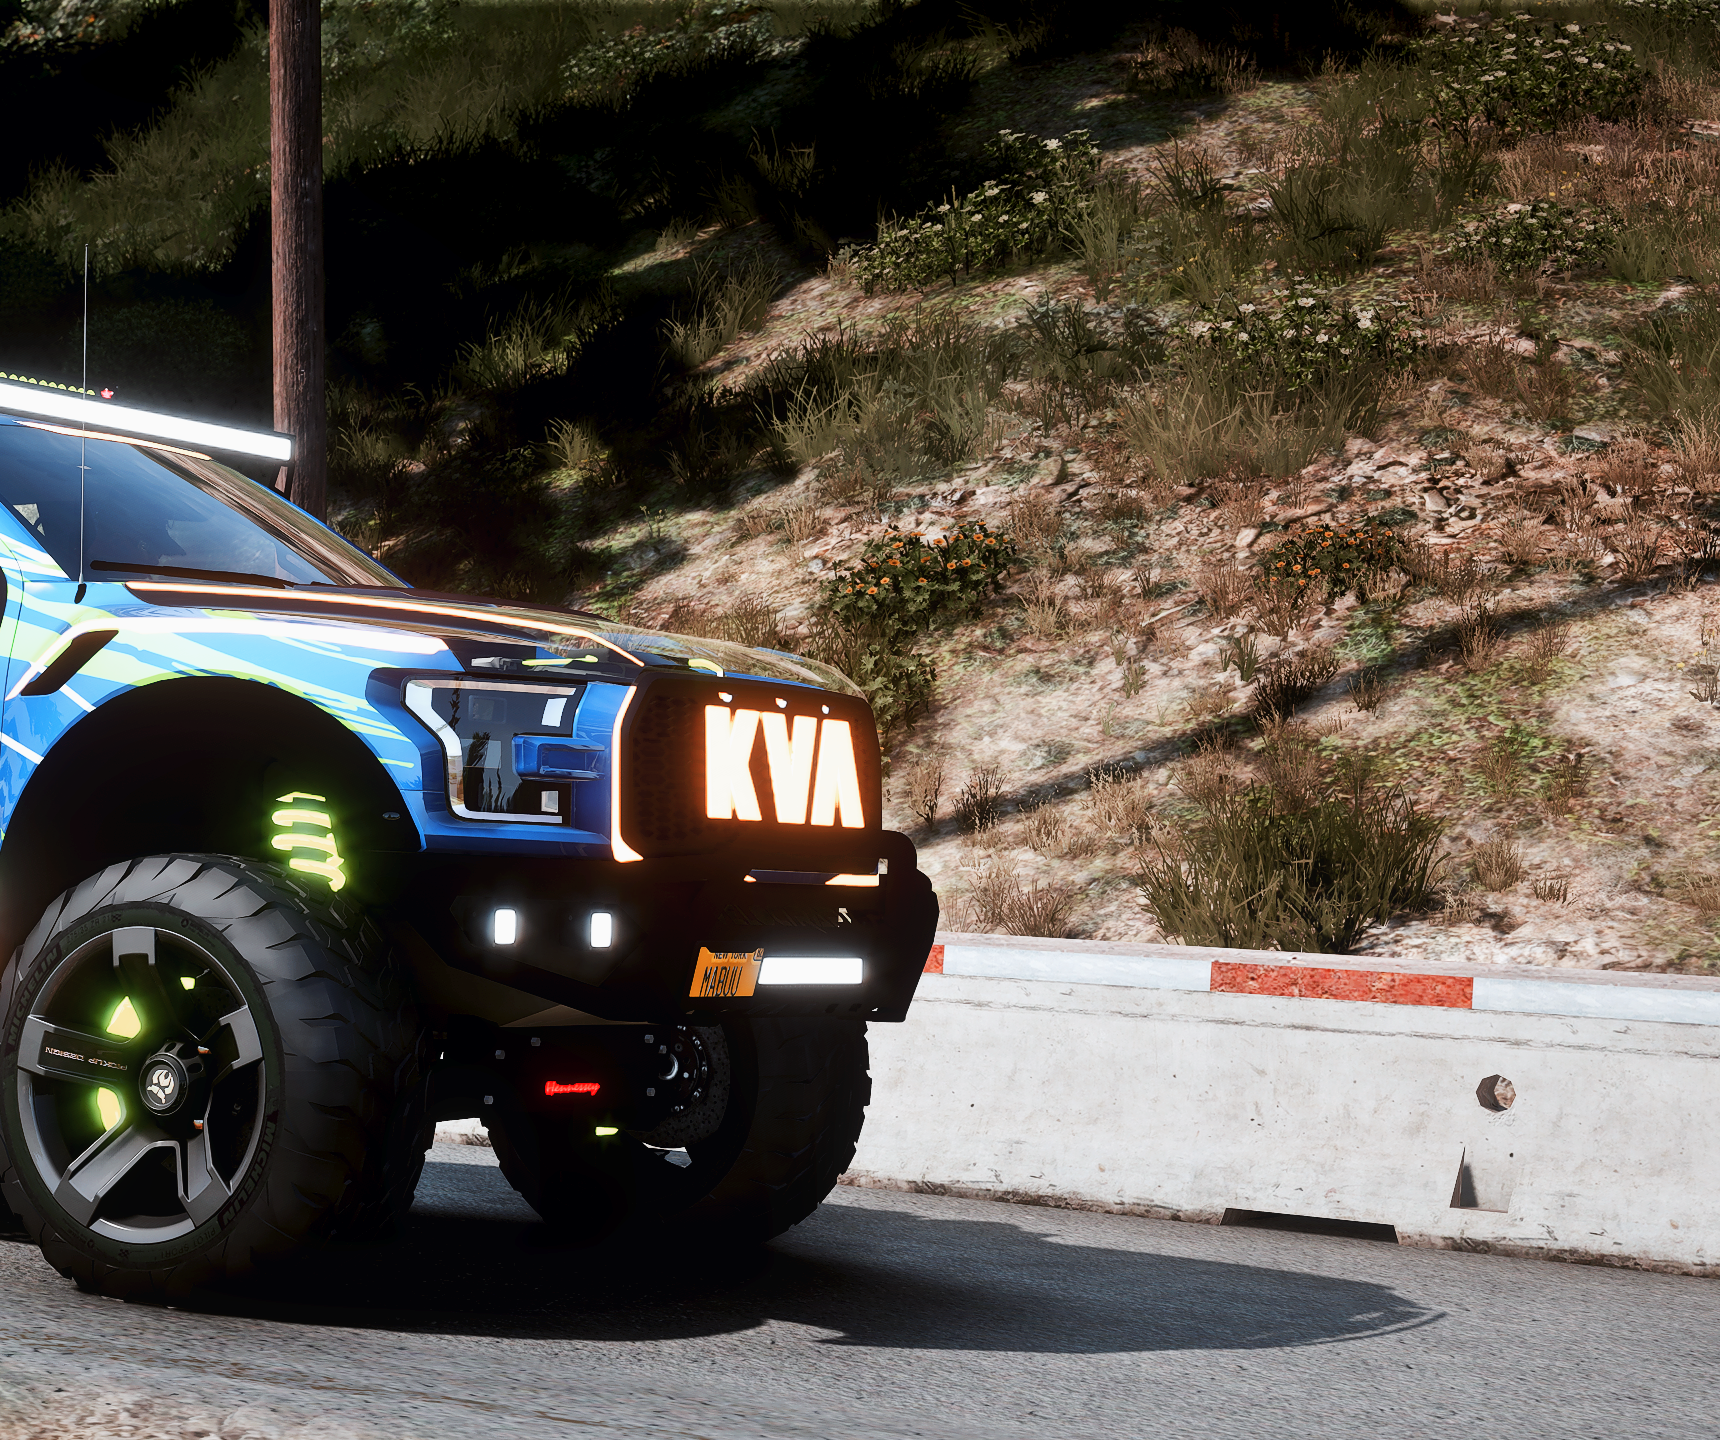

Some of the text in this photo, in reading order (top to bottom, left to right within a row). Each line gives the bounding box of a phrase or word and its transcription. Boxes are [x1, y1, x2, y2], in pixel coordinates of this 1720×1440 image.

[704, 704, 866, 829] KVA
[6, 945, 60, 1047] MICHELIN
[545, 1080, 600, 1096] Hennessey
[219, 1121, 277, 1229] MICHELIN
